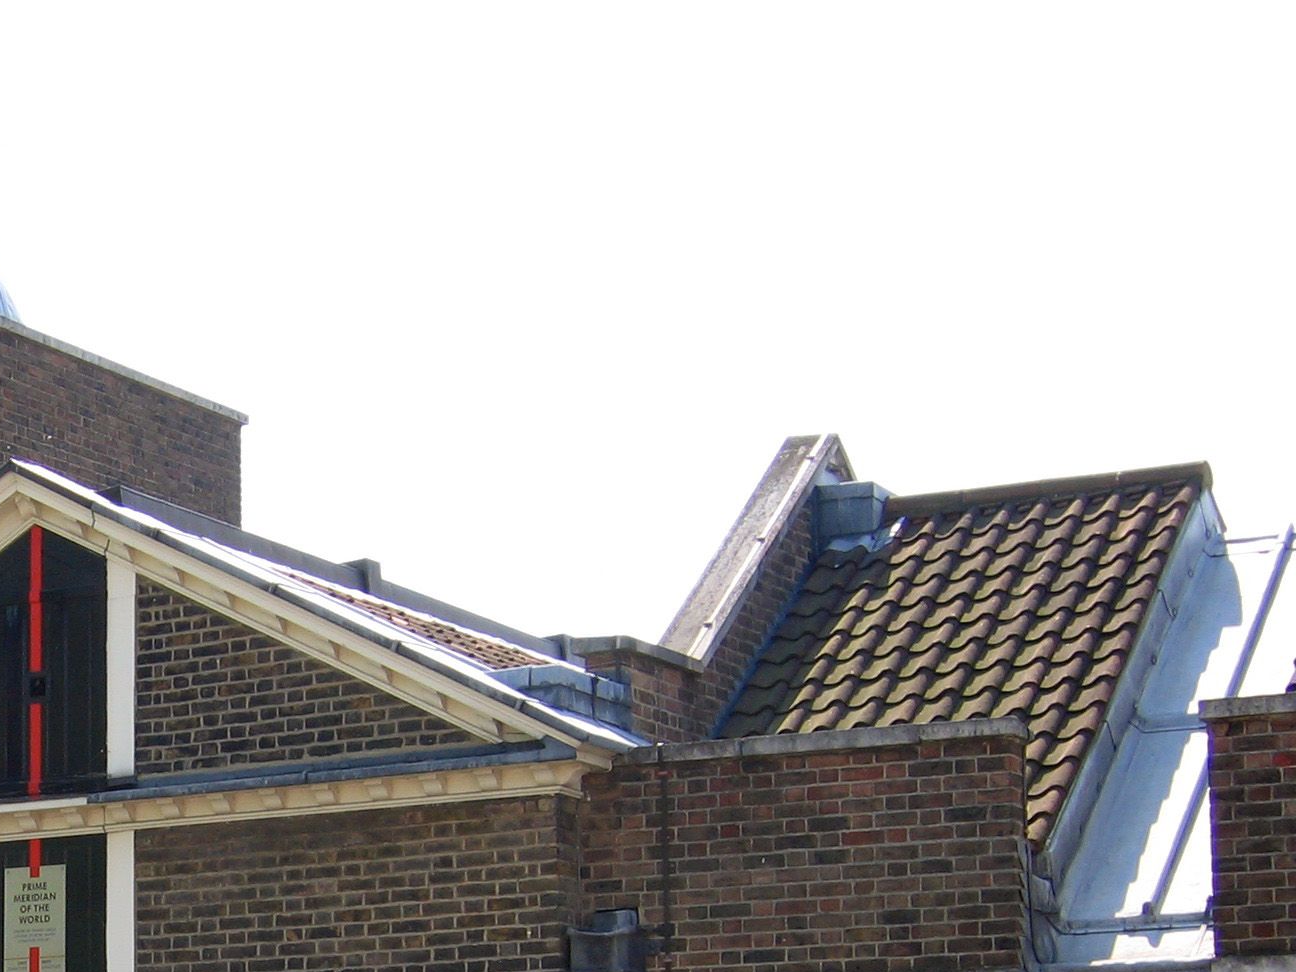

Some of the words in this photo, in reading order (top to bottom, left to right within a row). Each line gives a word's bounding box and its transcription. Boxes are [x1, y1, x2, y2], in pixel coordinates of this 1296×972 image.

[22, 882, 48, 891] PRIME
[13, 892, 57, 903] MERIDIAN
[20, 904, 31, 914] OF
[34, 903, 49, 913] THE
[19, 914, 51, 924] WORLD
